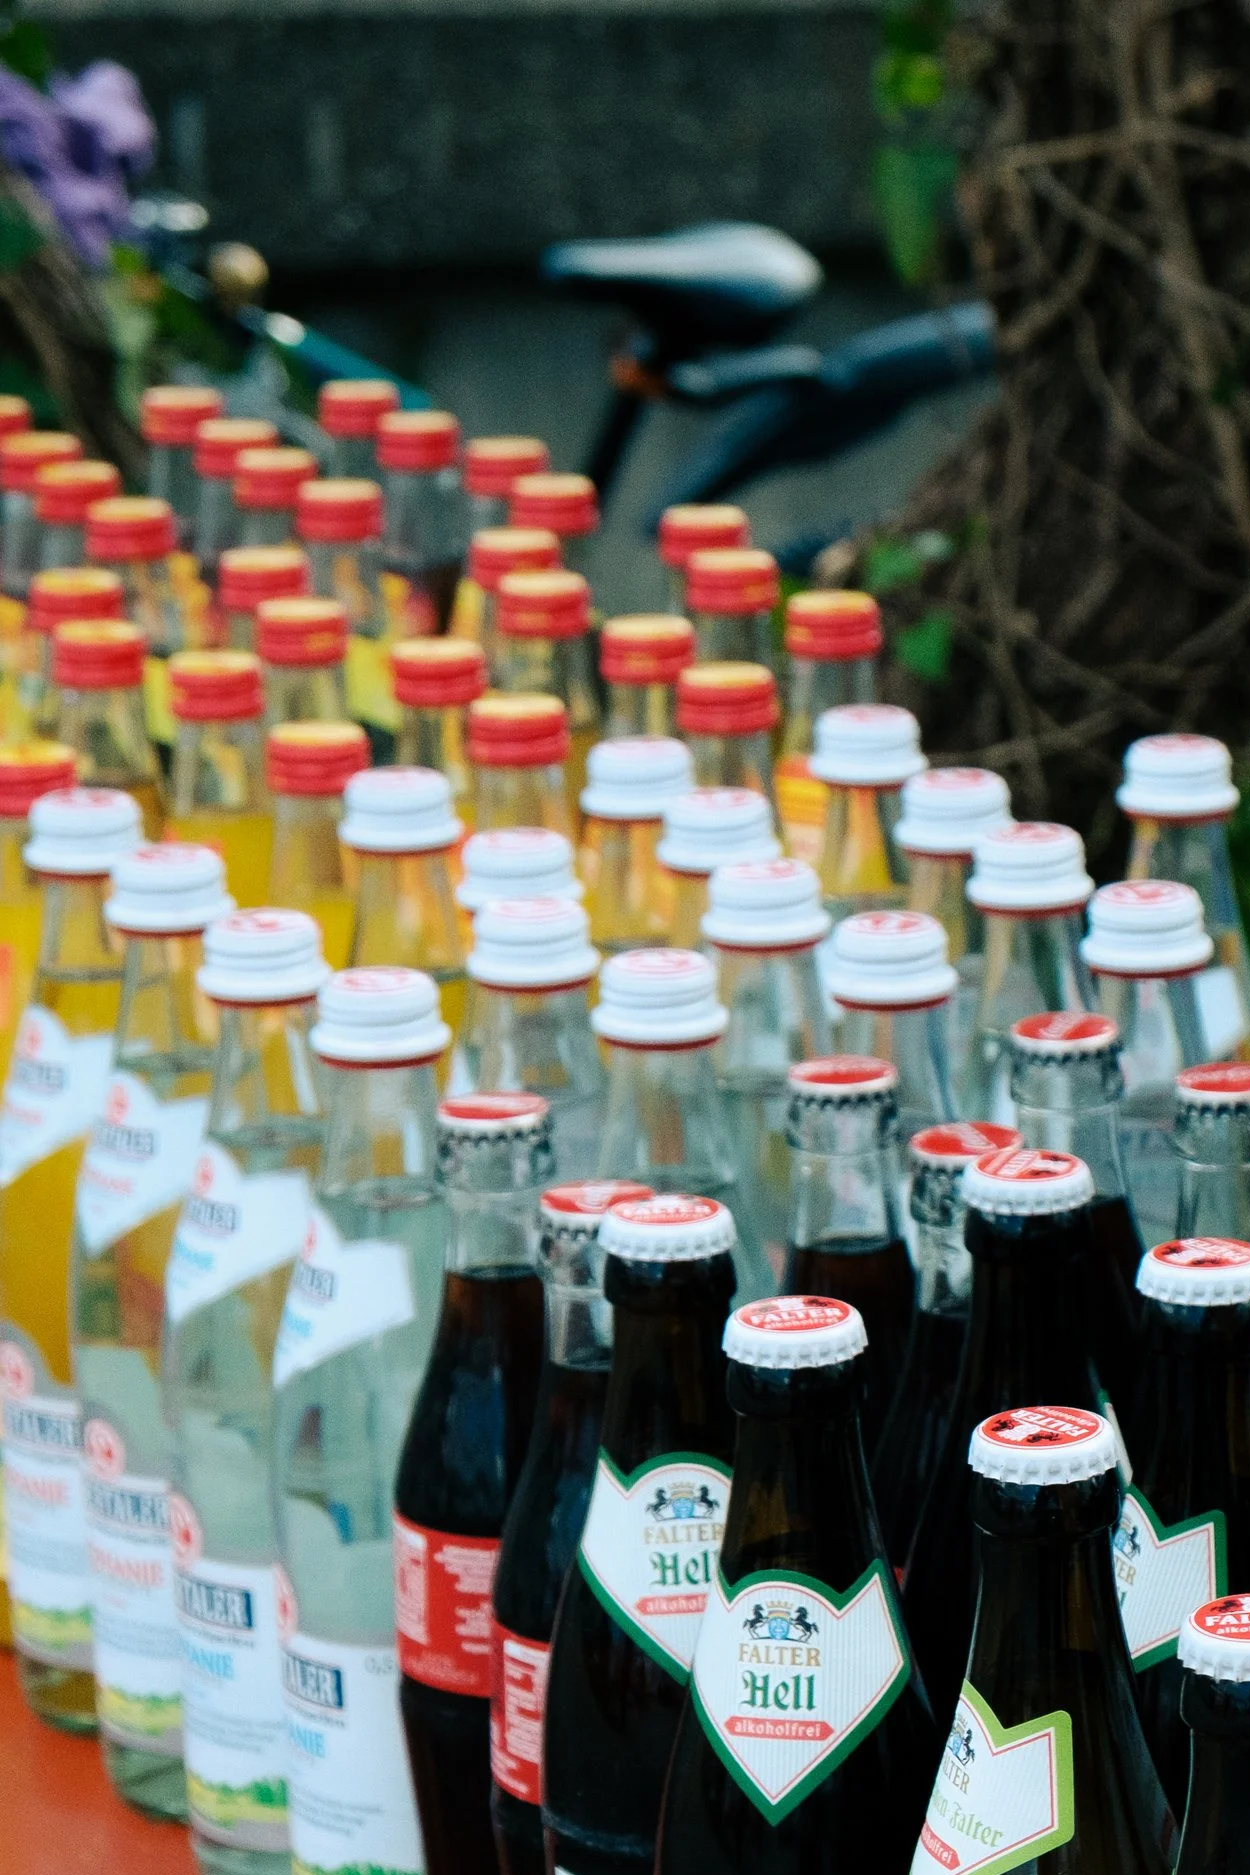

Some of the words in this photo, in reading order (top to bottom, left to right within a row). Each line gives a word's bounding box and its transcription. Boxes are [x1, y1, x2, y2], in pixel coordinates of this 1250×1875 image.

[750, 1305, 843, 1325] FALTER
[1010, 1409, 1089, 1437] FALTER
[738, 1642, 822, 1668] FALTER
[740, 1669, 816, 1712] Hell
[733, 1718, 822, 1738] alkoholfrei
